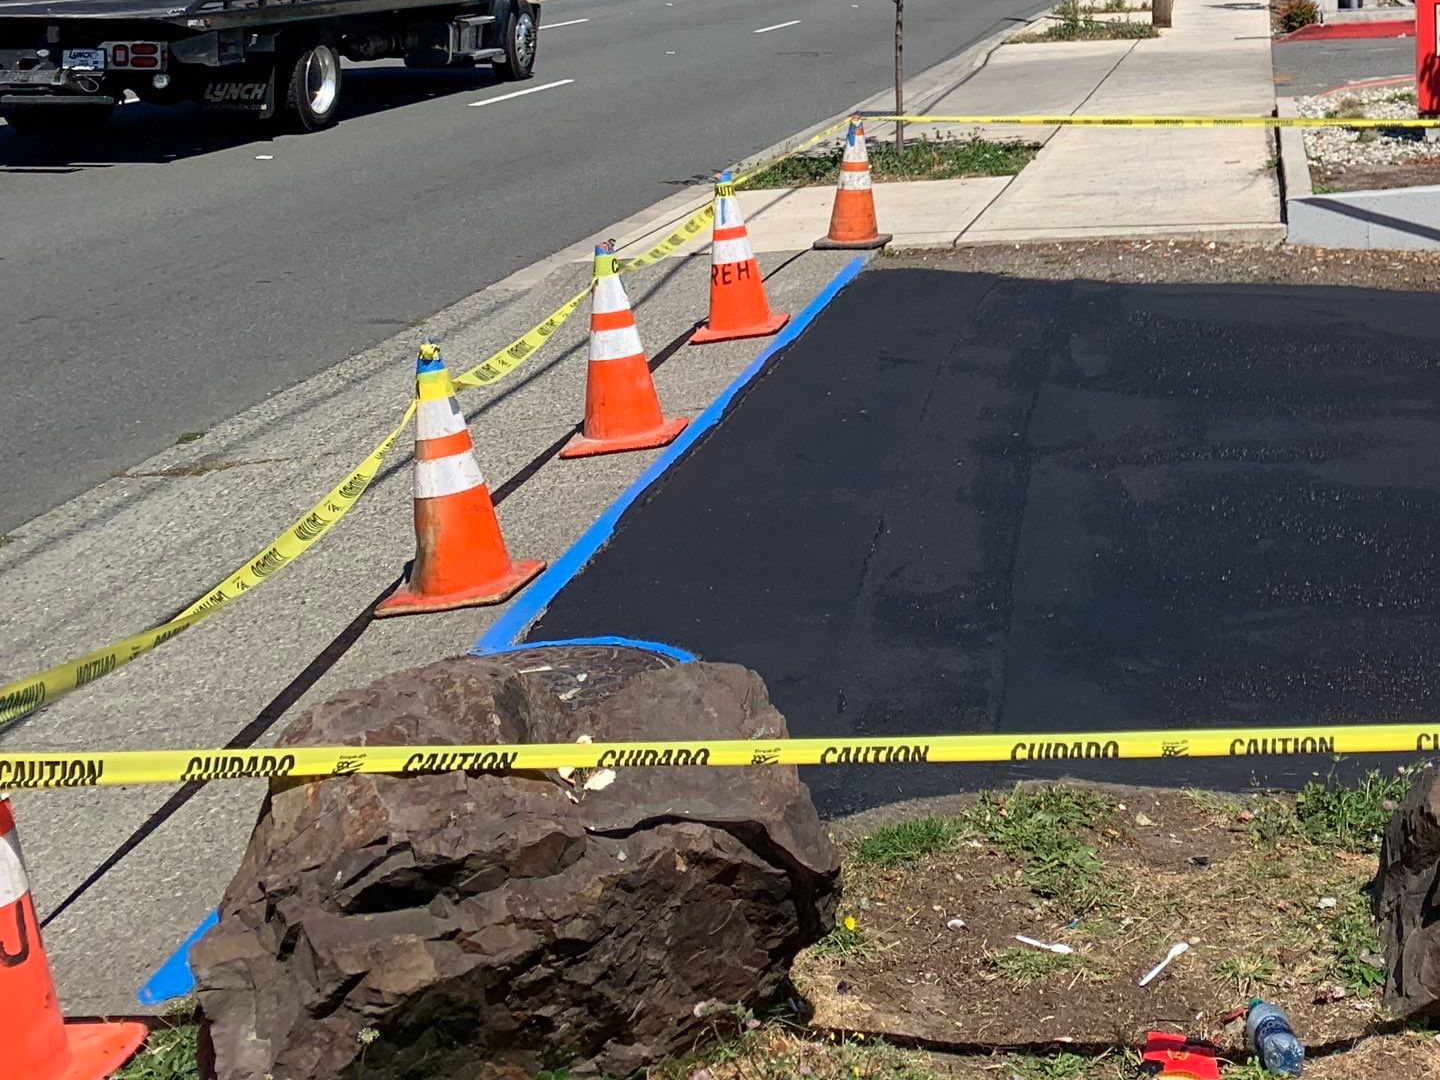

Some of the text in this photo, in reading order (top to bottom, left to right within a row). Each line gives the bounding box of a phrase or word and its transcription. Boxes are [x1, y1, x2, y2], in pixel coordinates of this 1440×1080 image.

[204, 81, 268, 103] LYNCH
[0, 759, 104, 787] CAUTION
[820, 745, 930, 764] CAUTION
[1229, 736, 1335, 756] CAUTION
